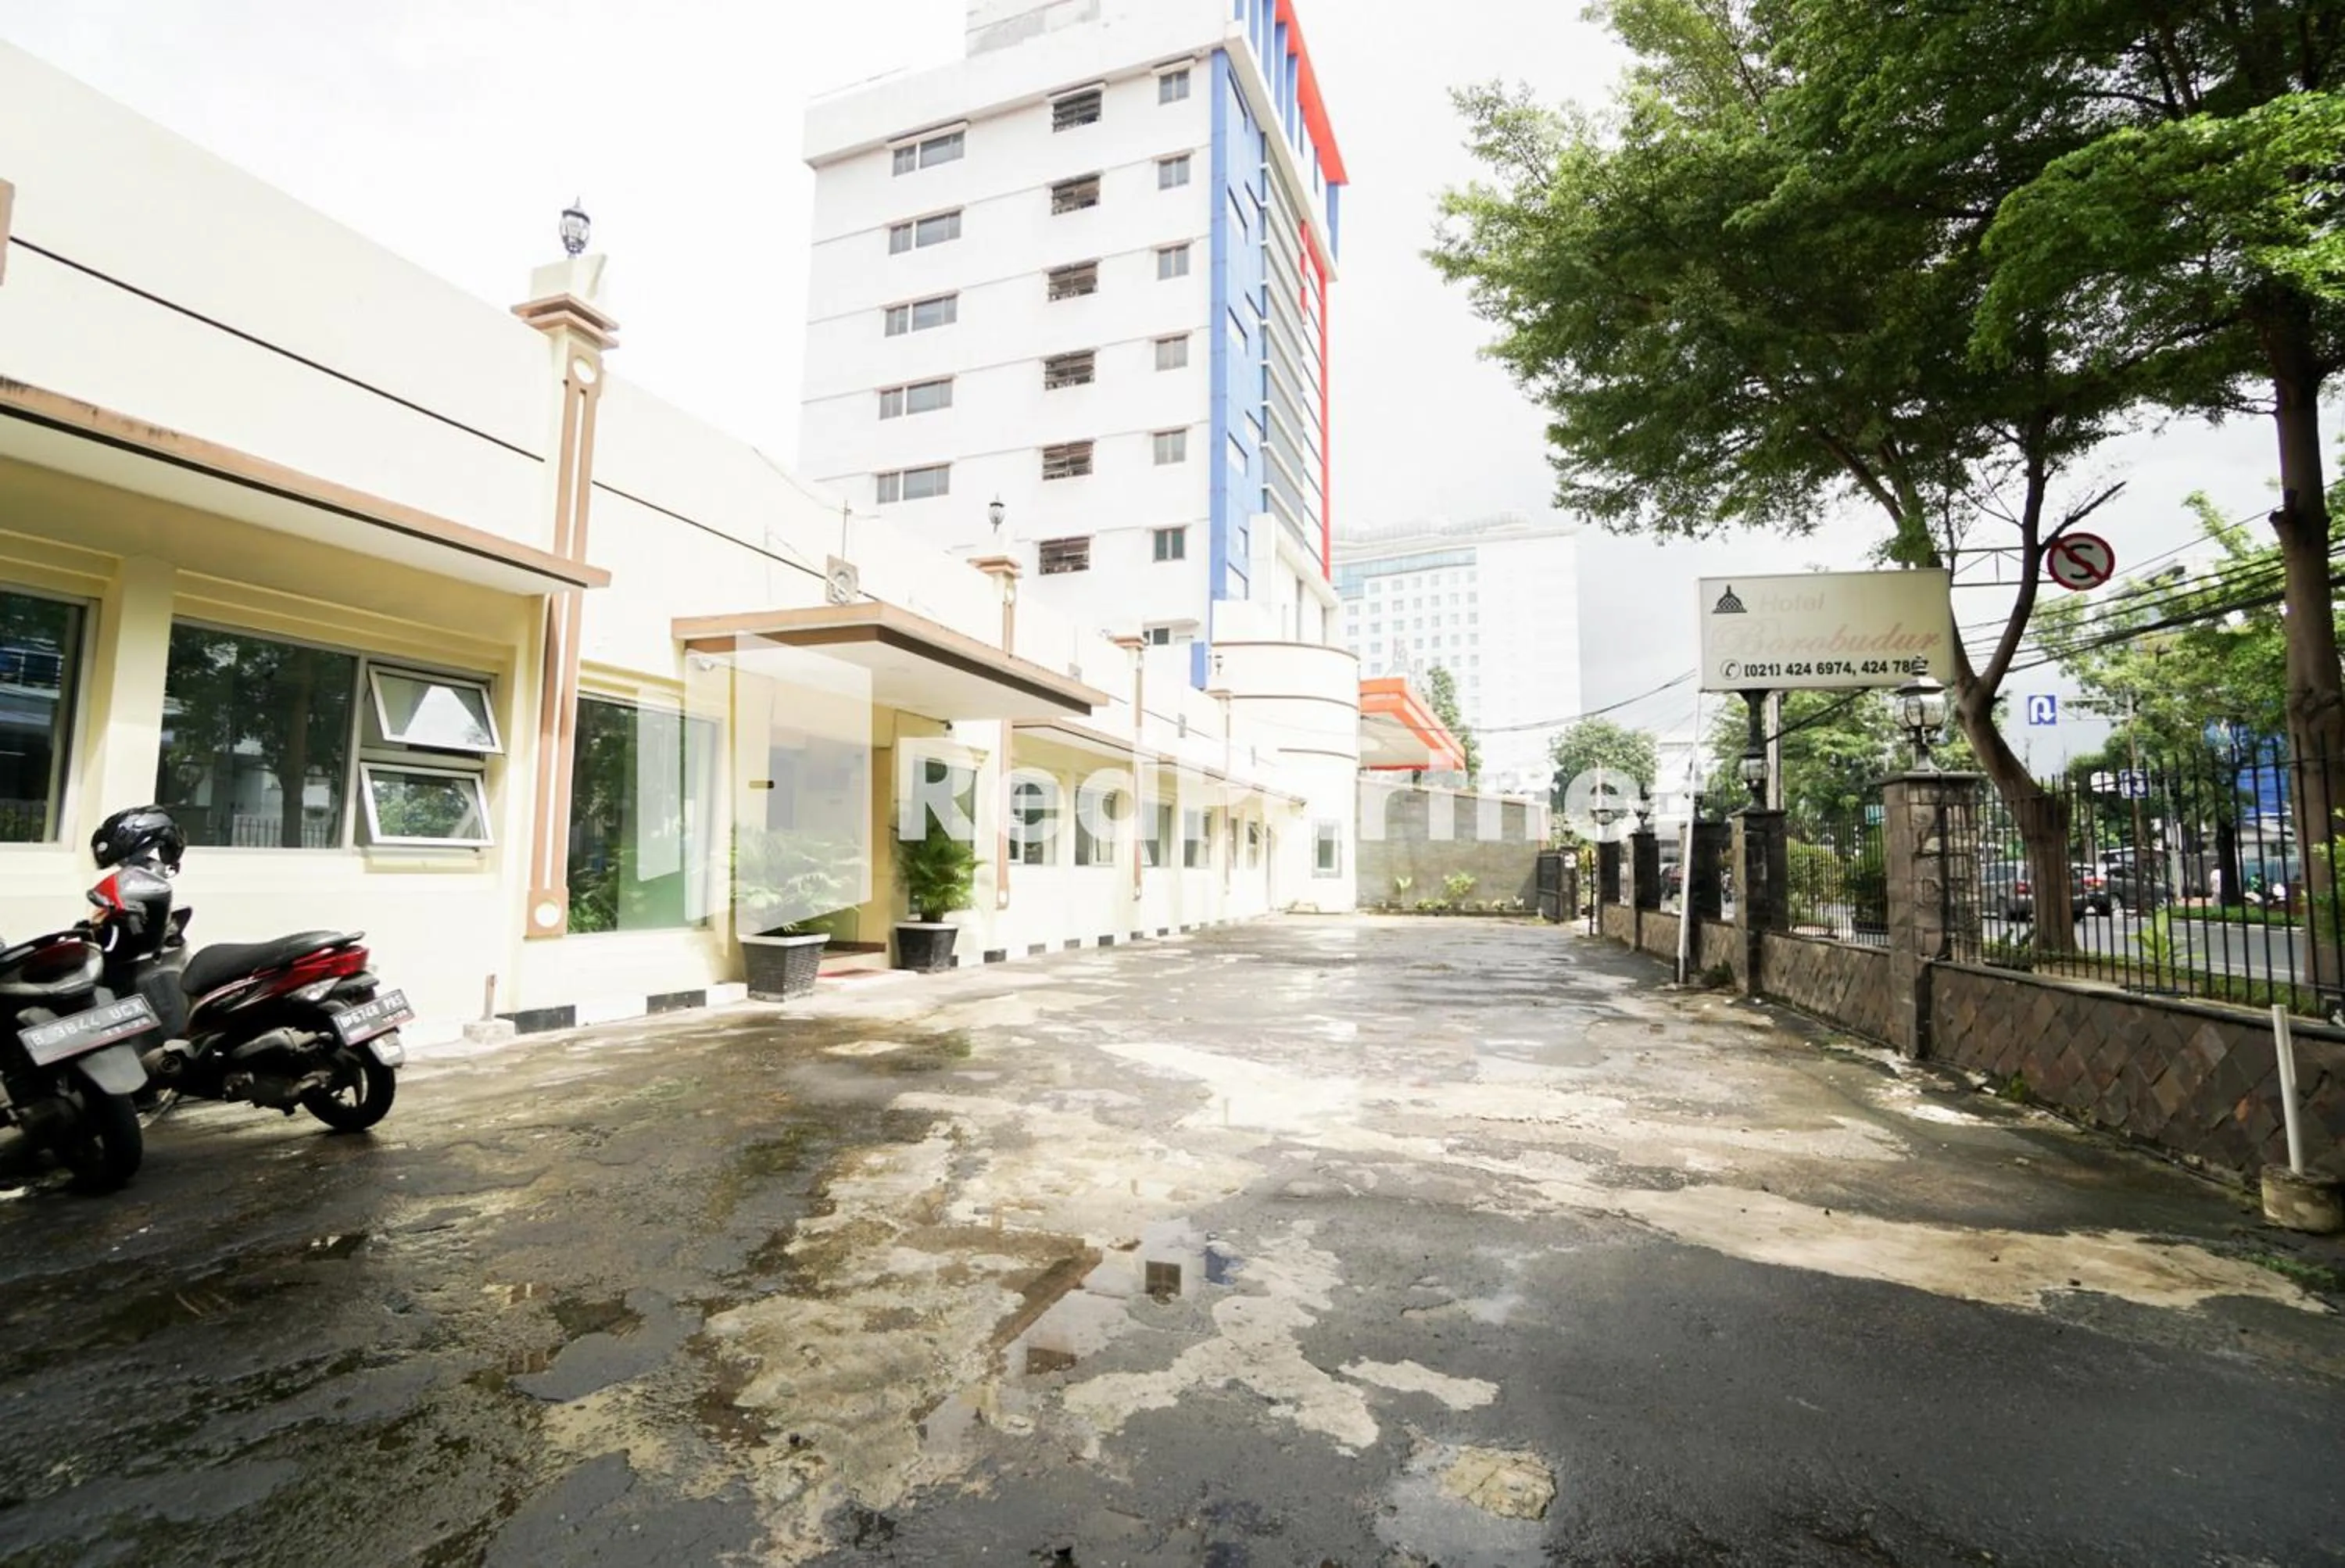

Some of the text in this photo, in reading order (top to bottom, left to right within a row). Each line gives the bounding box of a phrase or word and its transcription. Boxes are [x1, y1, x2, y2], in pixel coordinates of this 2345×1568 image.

[1760, 592, 1825, 614] Hotel
[1712, 618, 1942, 657] Borobudur
[1785, 661, 1812, 676] 424
[1816, 660, 1857, 677] 6974,
[1860, 660, 1889, 675] 424
[1892, 659, 1929, 675] 78
